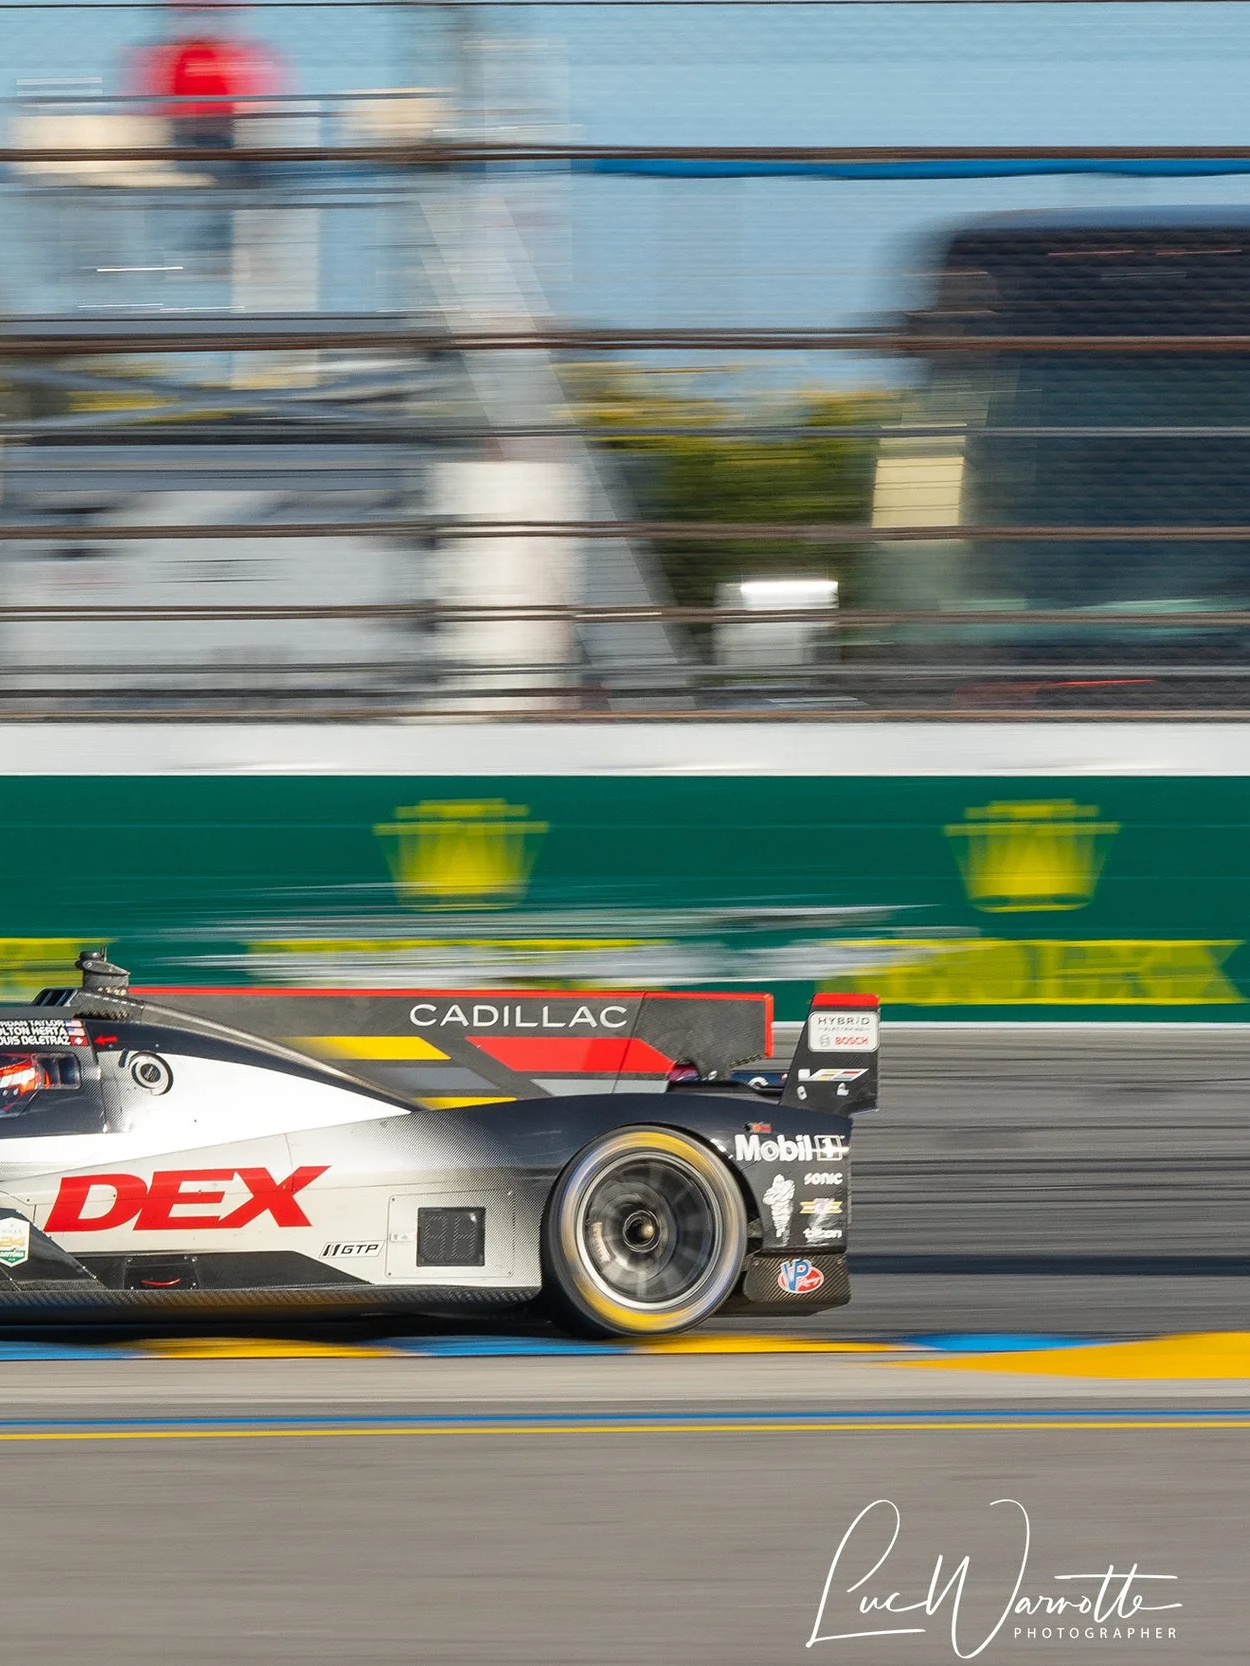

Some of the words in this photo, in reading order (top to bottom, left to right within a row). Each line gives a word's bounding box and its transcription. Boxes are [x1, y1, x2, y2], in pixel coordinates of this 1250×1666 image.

[409, 1003, 628, 1029] CADILLAC
[817, 1016, 871, 1025] HYBRID
[31, 1026, 68, 1036] HERTA
[21, 1036, 71, 1046] DELETRAZ
[835, 1036, 869, 1046] BOSCH
[43, 1165, 332, 1233] DEX
[341, 1244, 379, 1255] GTP
